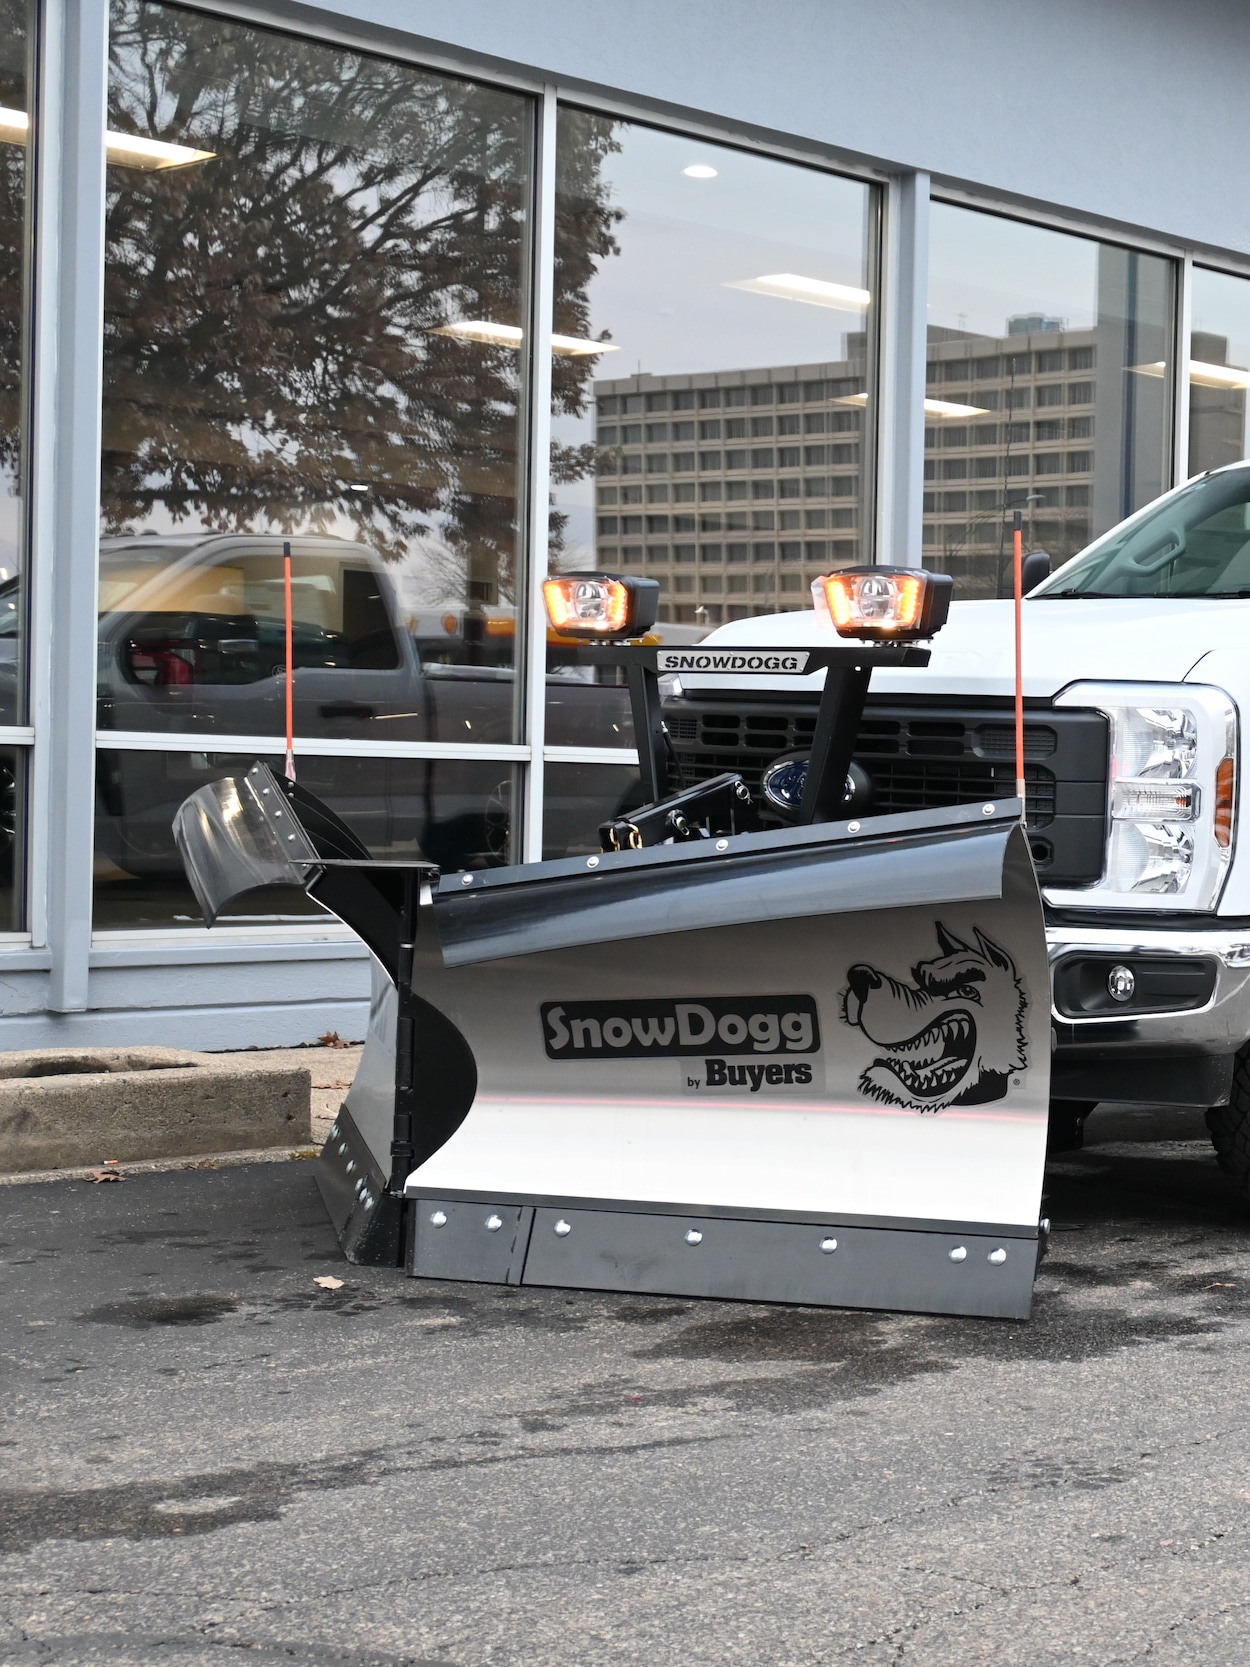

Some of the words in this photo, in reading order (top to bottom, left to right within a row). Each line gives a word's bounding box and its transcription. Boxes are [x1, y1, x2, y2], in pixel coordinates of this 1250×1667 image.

[664, 655, 798, 671] SNOWDOGG
[546, 1003, 814, 1052] SnowDogg
[686, 1076, 701, 1089] by
[705, 1058, 813, 1092] Buyers
